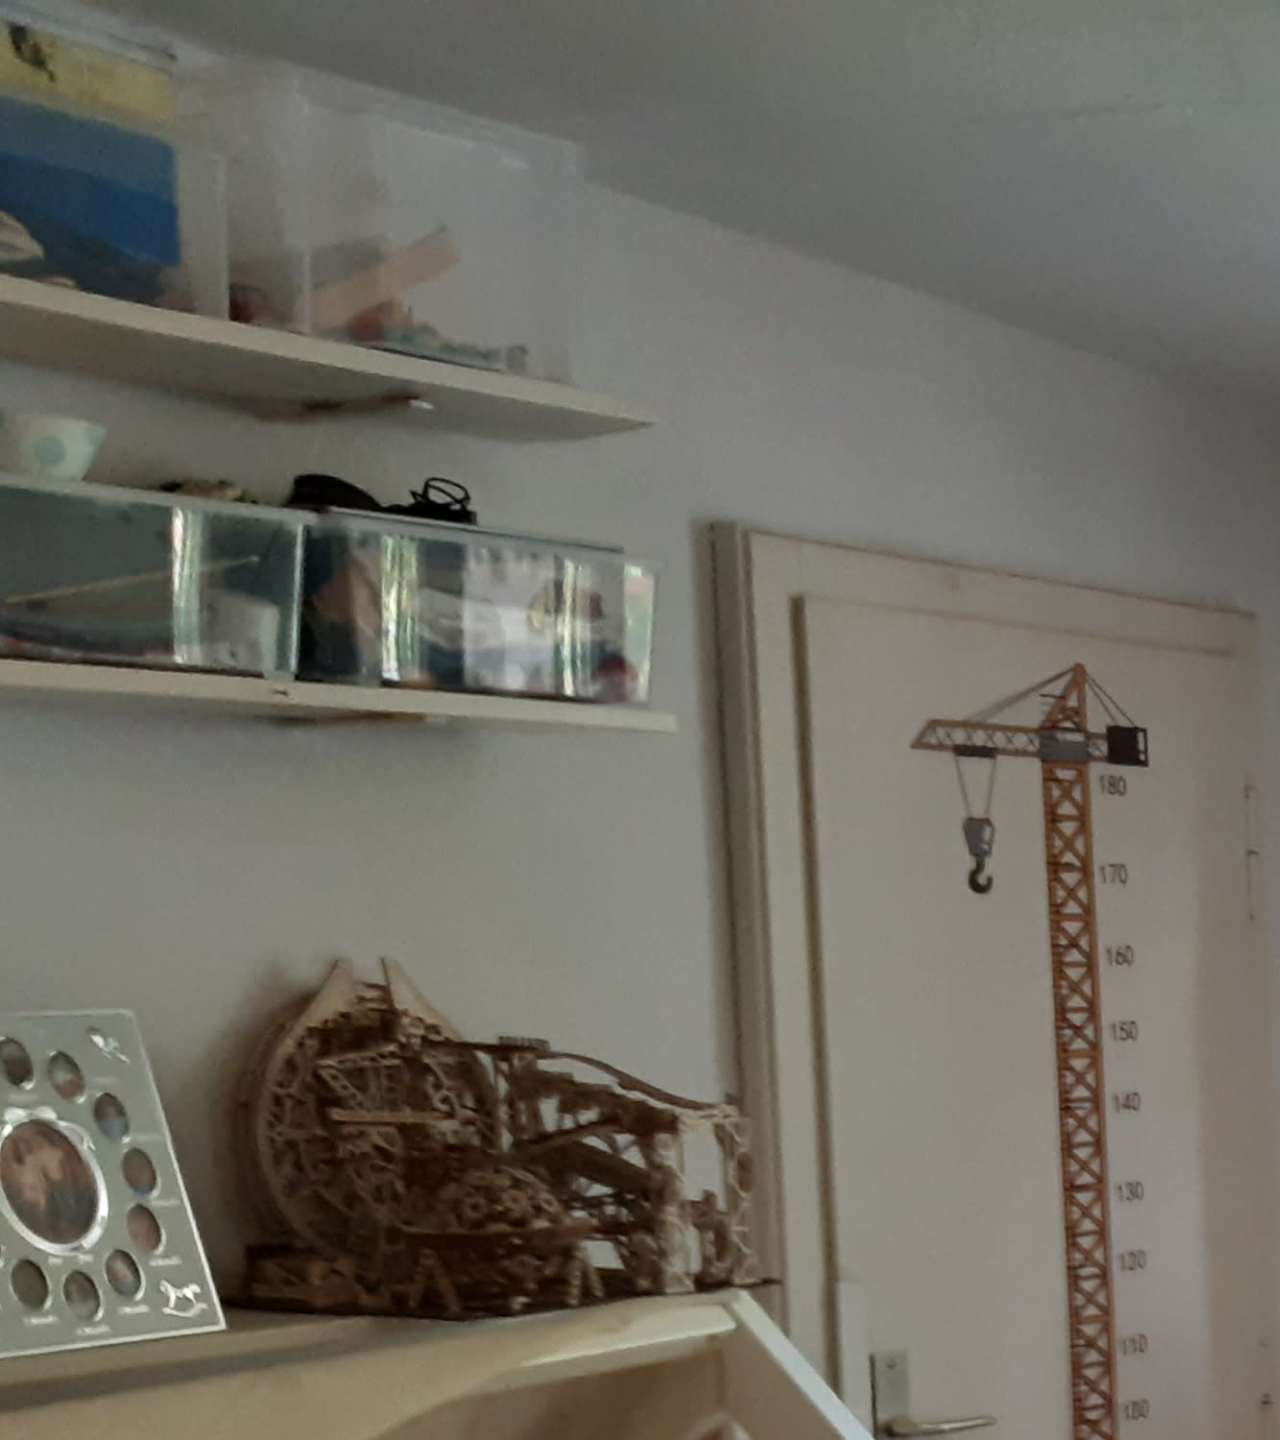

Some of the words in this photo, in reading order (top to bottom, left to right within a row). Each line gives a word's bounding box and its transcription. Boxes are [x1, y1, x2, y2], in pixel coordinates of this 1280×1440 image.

[1100, 775, 1127, 796] 180
[1099, 863, 1128, 884] 170
[1106, 945, 1134, 966] 160
[1110, 1020, 1138, 1041] 150
[1113, 1091, 1141, 1112] 140
[1117, 1181, 1144, 1201] 130
